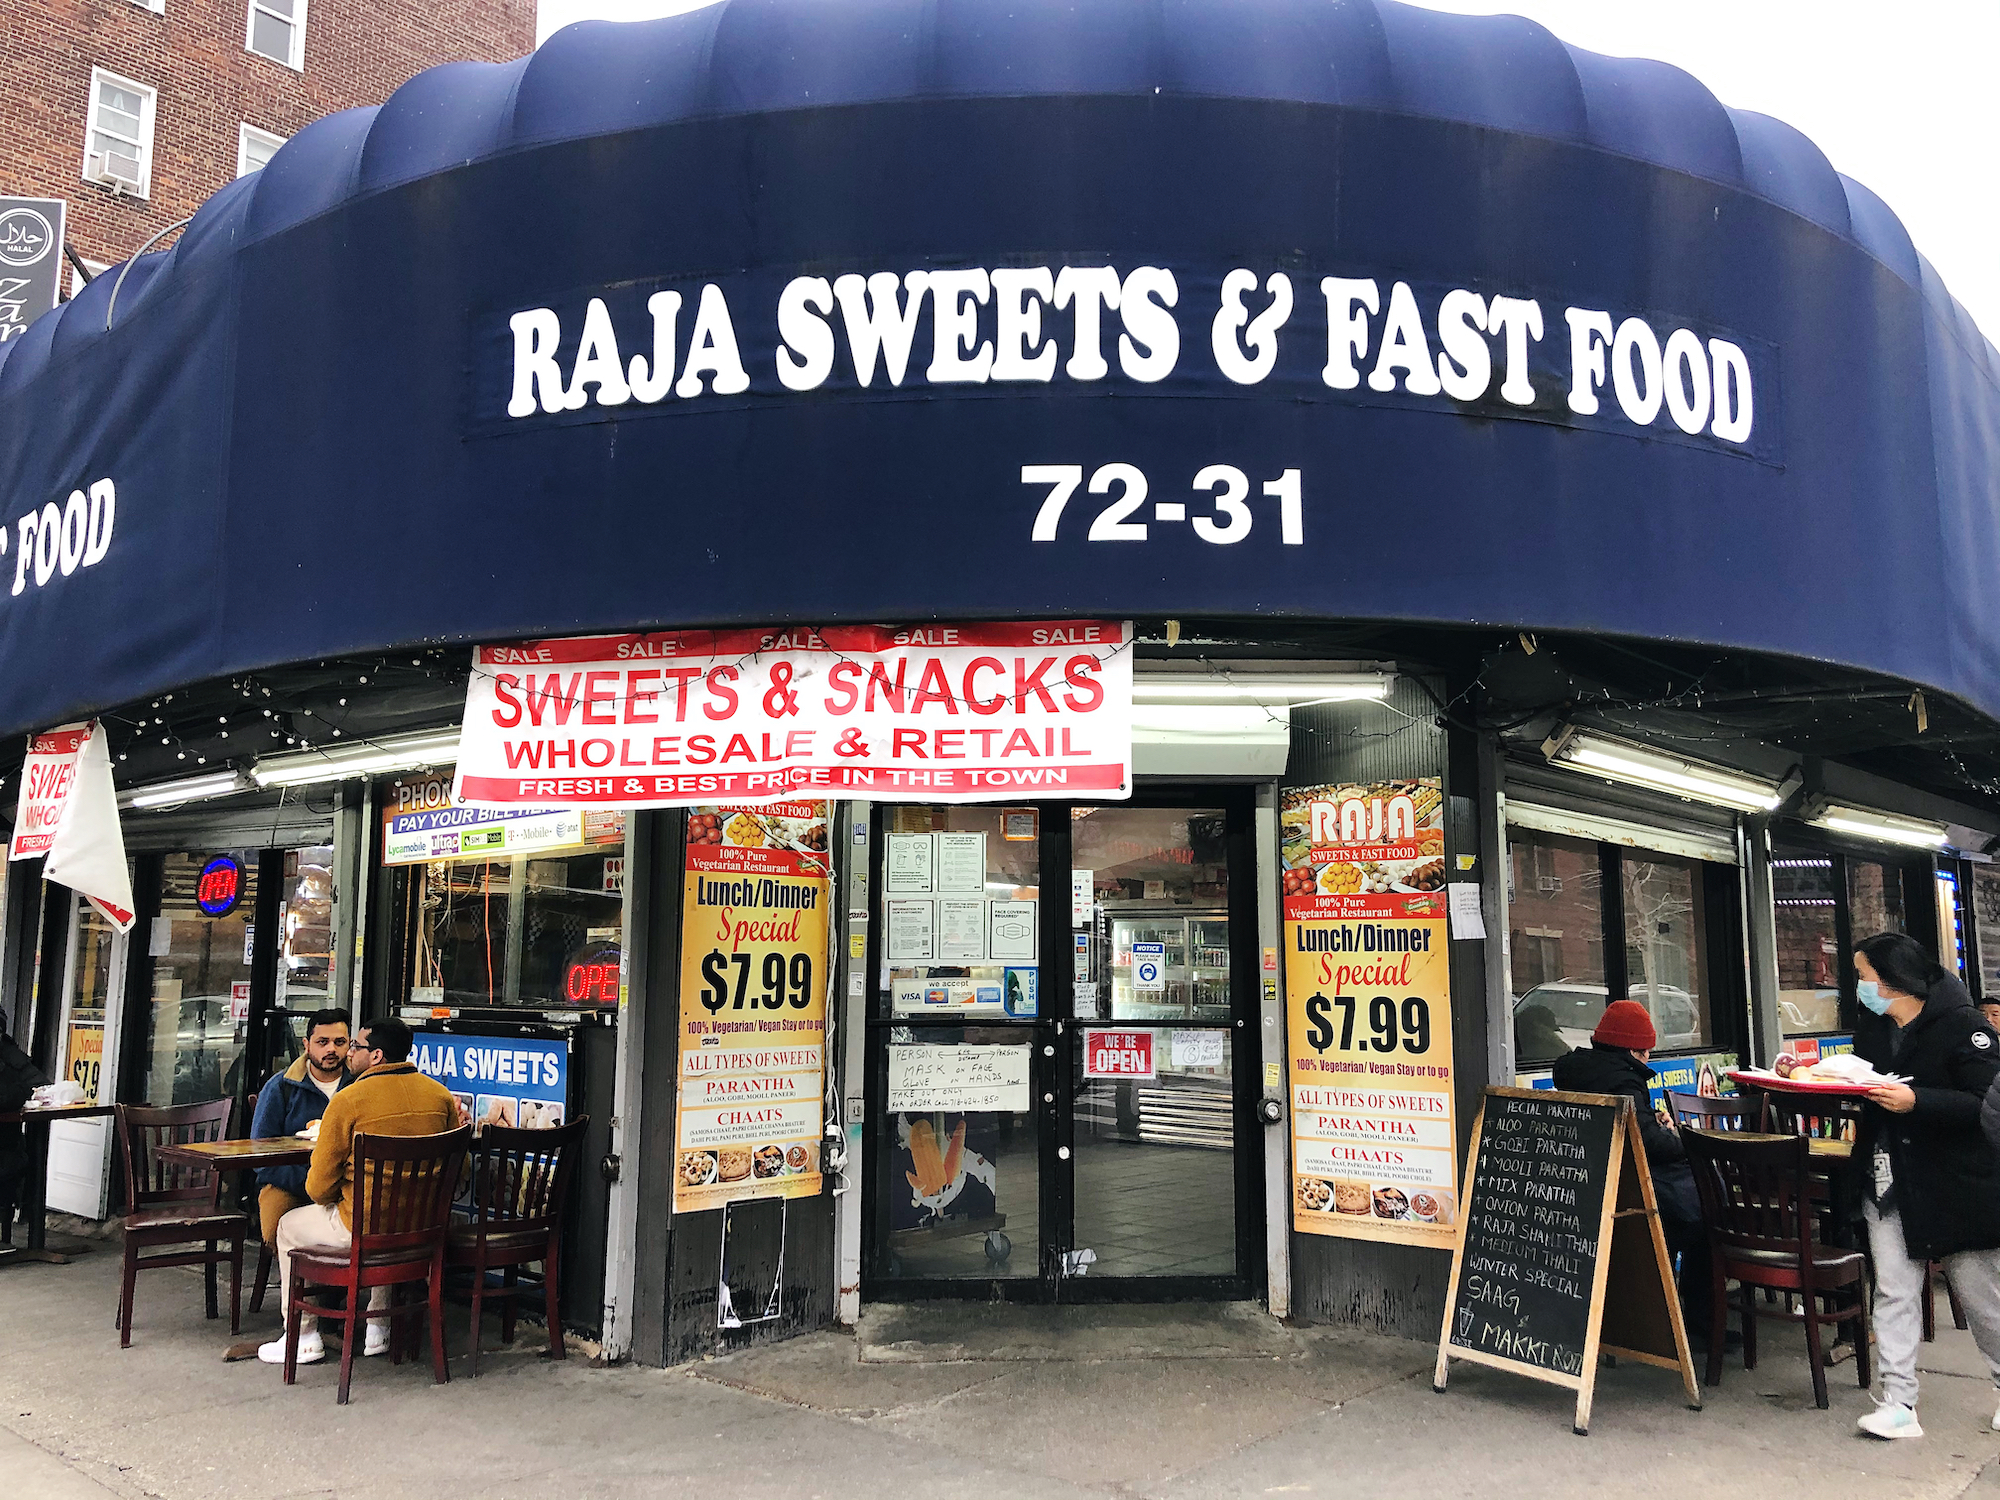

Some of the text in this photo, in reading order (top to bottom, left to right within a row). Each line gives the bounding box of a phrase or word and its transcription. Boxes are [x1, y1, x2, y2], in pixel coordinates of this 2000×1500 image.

[7, 244, 33, 253] HALAL
[507, 266, 1753, 443] RAJA SWEETS & FAST FOOD
[1020, 463, 1304, 545] 72-31
[12, 477, 116, 596] FOOD
[493, 627, 1101, 663] SALE SALE SALE SALE SALE
[492, 655, 1104, 728] SWEETS & SNACKS
[34, 741, 57, 753] SALE
[504, 727, 1092, 770] WHOLESALE & RETAIL
[518, 767, 1068, 796] FRESH & BEST PRICE IN THE TOWN
[398, 815, 427, 832] PAY
[429, 809, 474, 828] YOUR
[766, 804, 786, 816] FAST
[787, 806, 812, 818] FOOD
[1310, 794, 1416, 844] RAJA
[21, 836, 45, 848] FRESH
[388, 841, 427, 856] Lycamobile
[692, 857, 741, 872] Vegetarian
[743, 861, 790, 873] Restaurant
[719, 848, 767, 861] 100% Pure
[1311, 847, 1416, 861] SWEETS & FAST FOOD
[198, 869, 238, 902] OPEN
[697, 876, 818, 909] Lunch/Dinner
[1290, 907, 1392, 920] Vegetarian Restaurant
[1314, 897, 1365, 908] 100% Pure
[716, 907, 801, 952] Special
[1297, 924, 1431, 952] Lunch/Dinner
[700, 948, 812, 1015] $7.99
[942, 980, 969, 988] accept
[1318, 952, 1412, 995] Special
[900, 992, 921, 1000] VISA
[687, 1020, 709, 1035] 100%
[758, 1019, 781, 1033] Vegan
[782, 1019, 798, 1032] Stay
[798, 1020, 806, 1030] or
[806, 1019, 813, 1029] to
[814, 1020, 824, 1031] go
[1306, 992, 1430, 1055] $7.99
[1104, 1034, 1137, 1049] WE'RE
[686, 1050, 817, 1071] ALL TYPES OF SWEETS
[896, 1049, 933, 1061] PERSON
[1095, 1049, 1146, 1072] OPEN
[463, 1046, 560, 1087] SWEETS
[904, 1064, 946, 1077] MASK
[971, 1063, 993, 1072] FACE
[1296, 1058, 1317, 1071] 100%
[1369, 1062, 1395, 1076] Vegan
[1397, 1063, 1415, 1078] Stay
[1416, 1067, 1426, 1077] or
[1427, 1066, 1436, 1077] to
[1437, 1068, 1449, 1079] go
[706, 1076, 795, 1095] PARANTHA
[968, 1073, 1002, 1083] HANDS
[1663, 1069, 1688, 1087] SWEETS
[891, 1099, 904, 1108] FOR
[909, 1098, 932, 1106] ORDER
[892, 1088, 963, 1099] TAKE OUT ONLY
[1297, 1090, 1443, 1113] ALL TYPES OF SWEETS
[717, 1108, 783, 1126] CHAATS
[1547, 1104, 1592, 1121] PARATHA
[1318, 1116, 1416, 1135] PARANTHA
[1496, 1118, 1578, 1140] ALOO PARATHA
[1331, 1146, 1404, 1164] CHAATS
[1494, 1136, 1586, 1159] GOBI PARATHA
[1493, 1156, 1589, 1184] MOOLI PARATHA
[1488, 1176, 1576, 1206] MIX PARATHA
[1486, 1195, 1581, 1232] ONION PRATHA
[1483, 1214, 1516, 1236] RAJA
[1565, 1233, 1598, 1258] THALI
[1481, 1235, 1582, 1275] MEDIUM THALI
[1469, 1253, 1583, 1300] WINTER SPECIAL
[1465, 1275, 1521, 1315] SAAG
[1481, 1321, 1550, 1366] MAKKI
